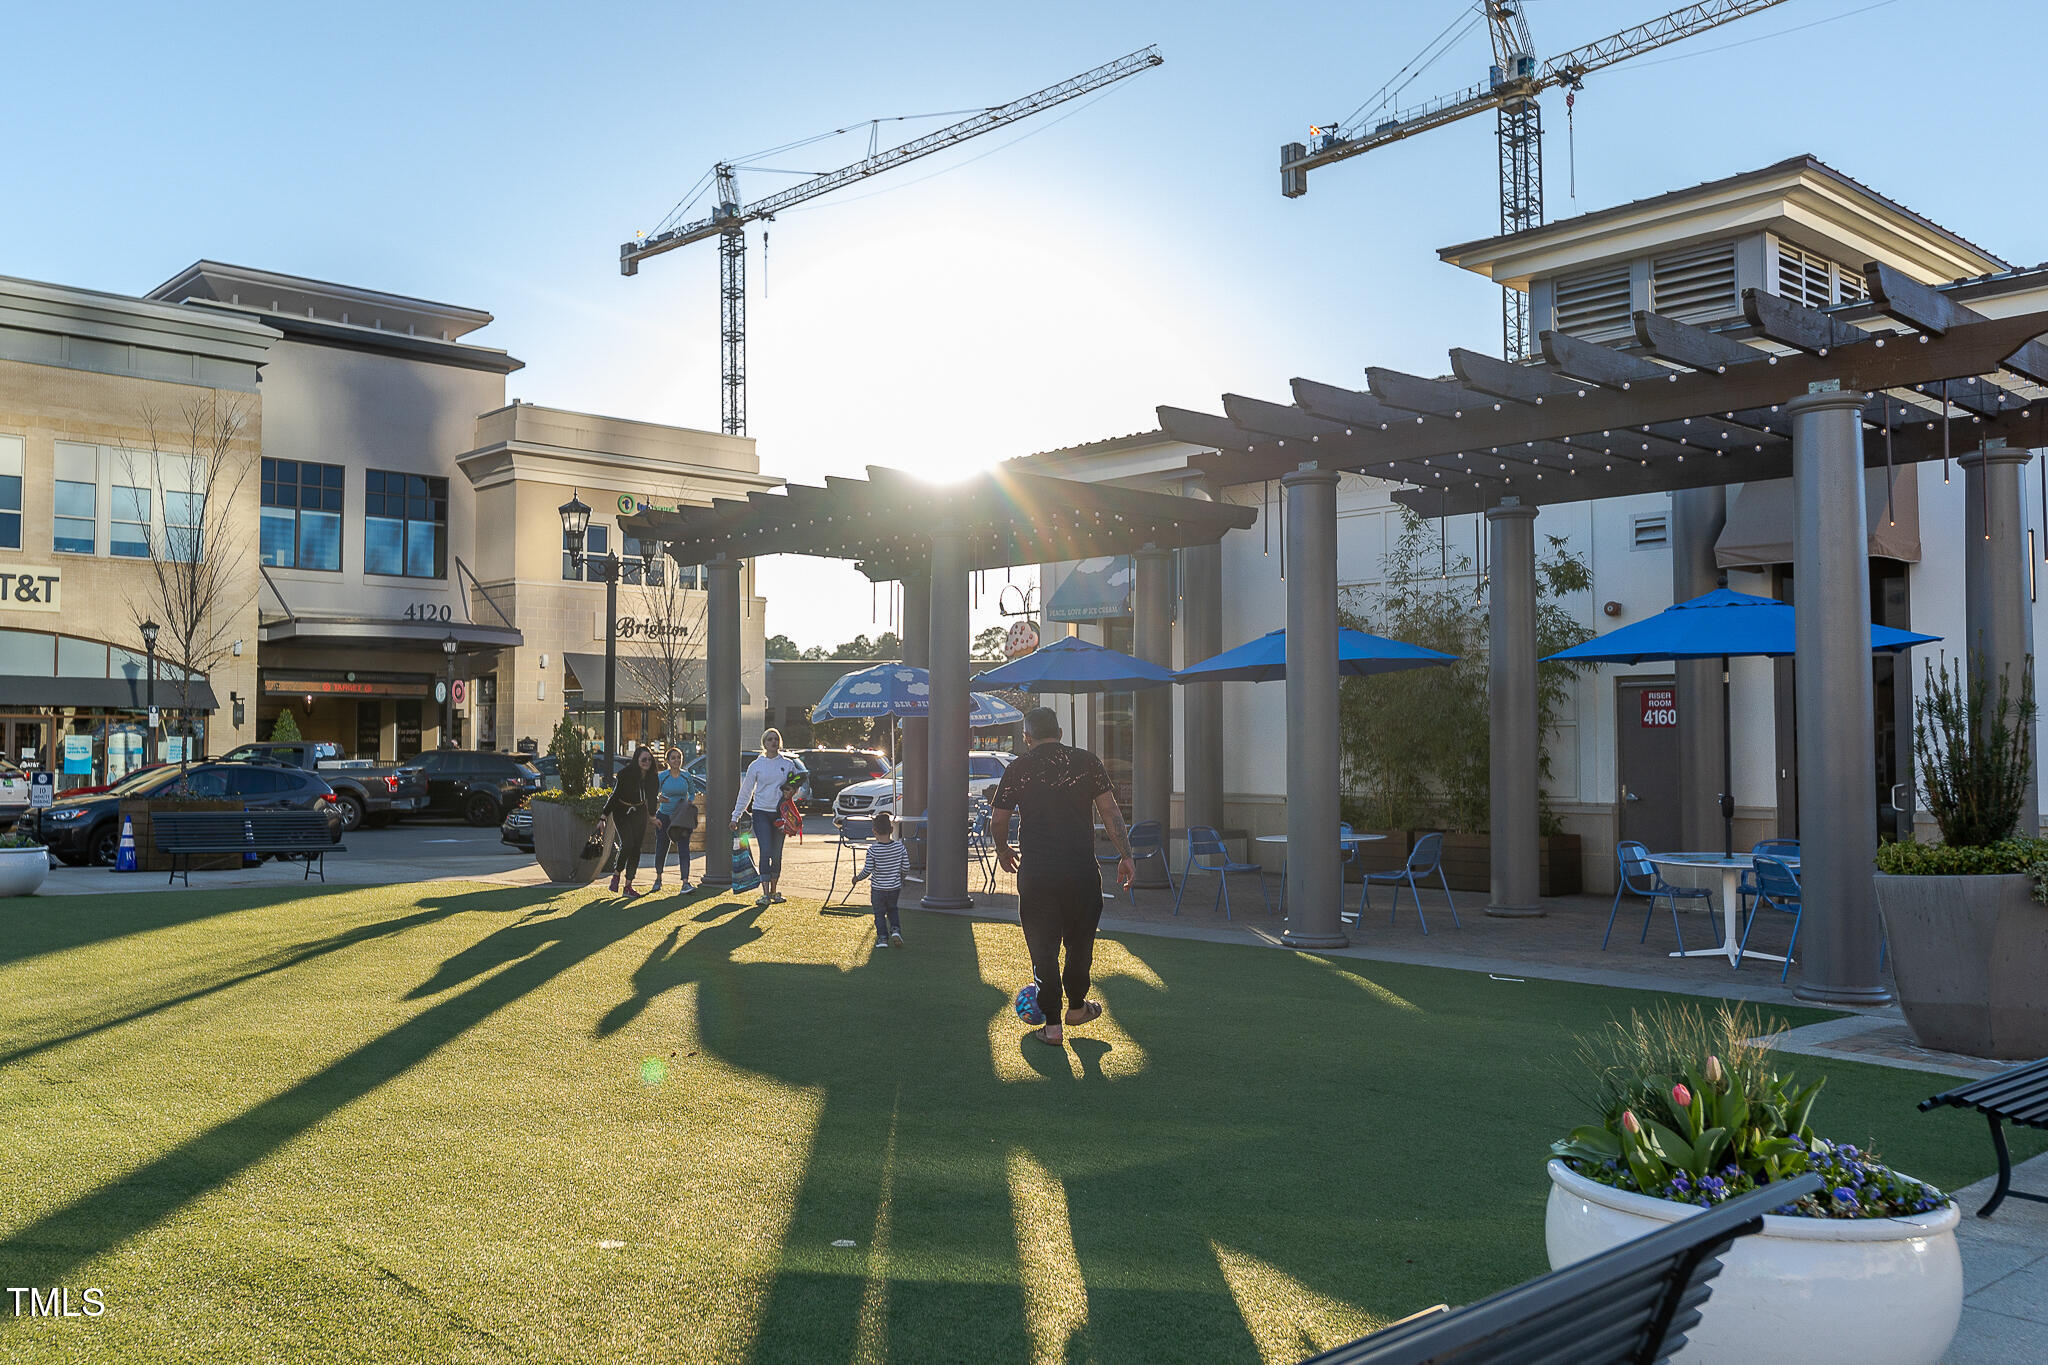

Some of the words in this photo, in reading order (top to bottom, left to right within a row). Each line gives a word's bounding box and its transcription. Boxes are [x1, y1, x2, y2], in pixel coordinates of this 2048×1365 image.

[0, 573, 60, 603] T&T
[402, 603, 452, 622] 4120
[616, 616, 689, 640] Brighton
[1648, 692, 1671, 700] RISER
[1643, 709, 1677, 725] 4160
